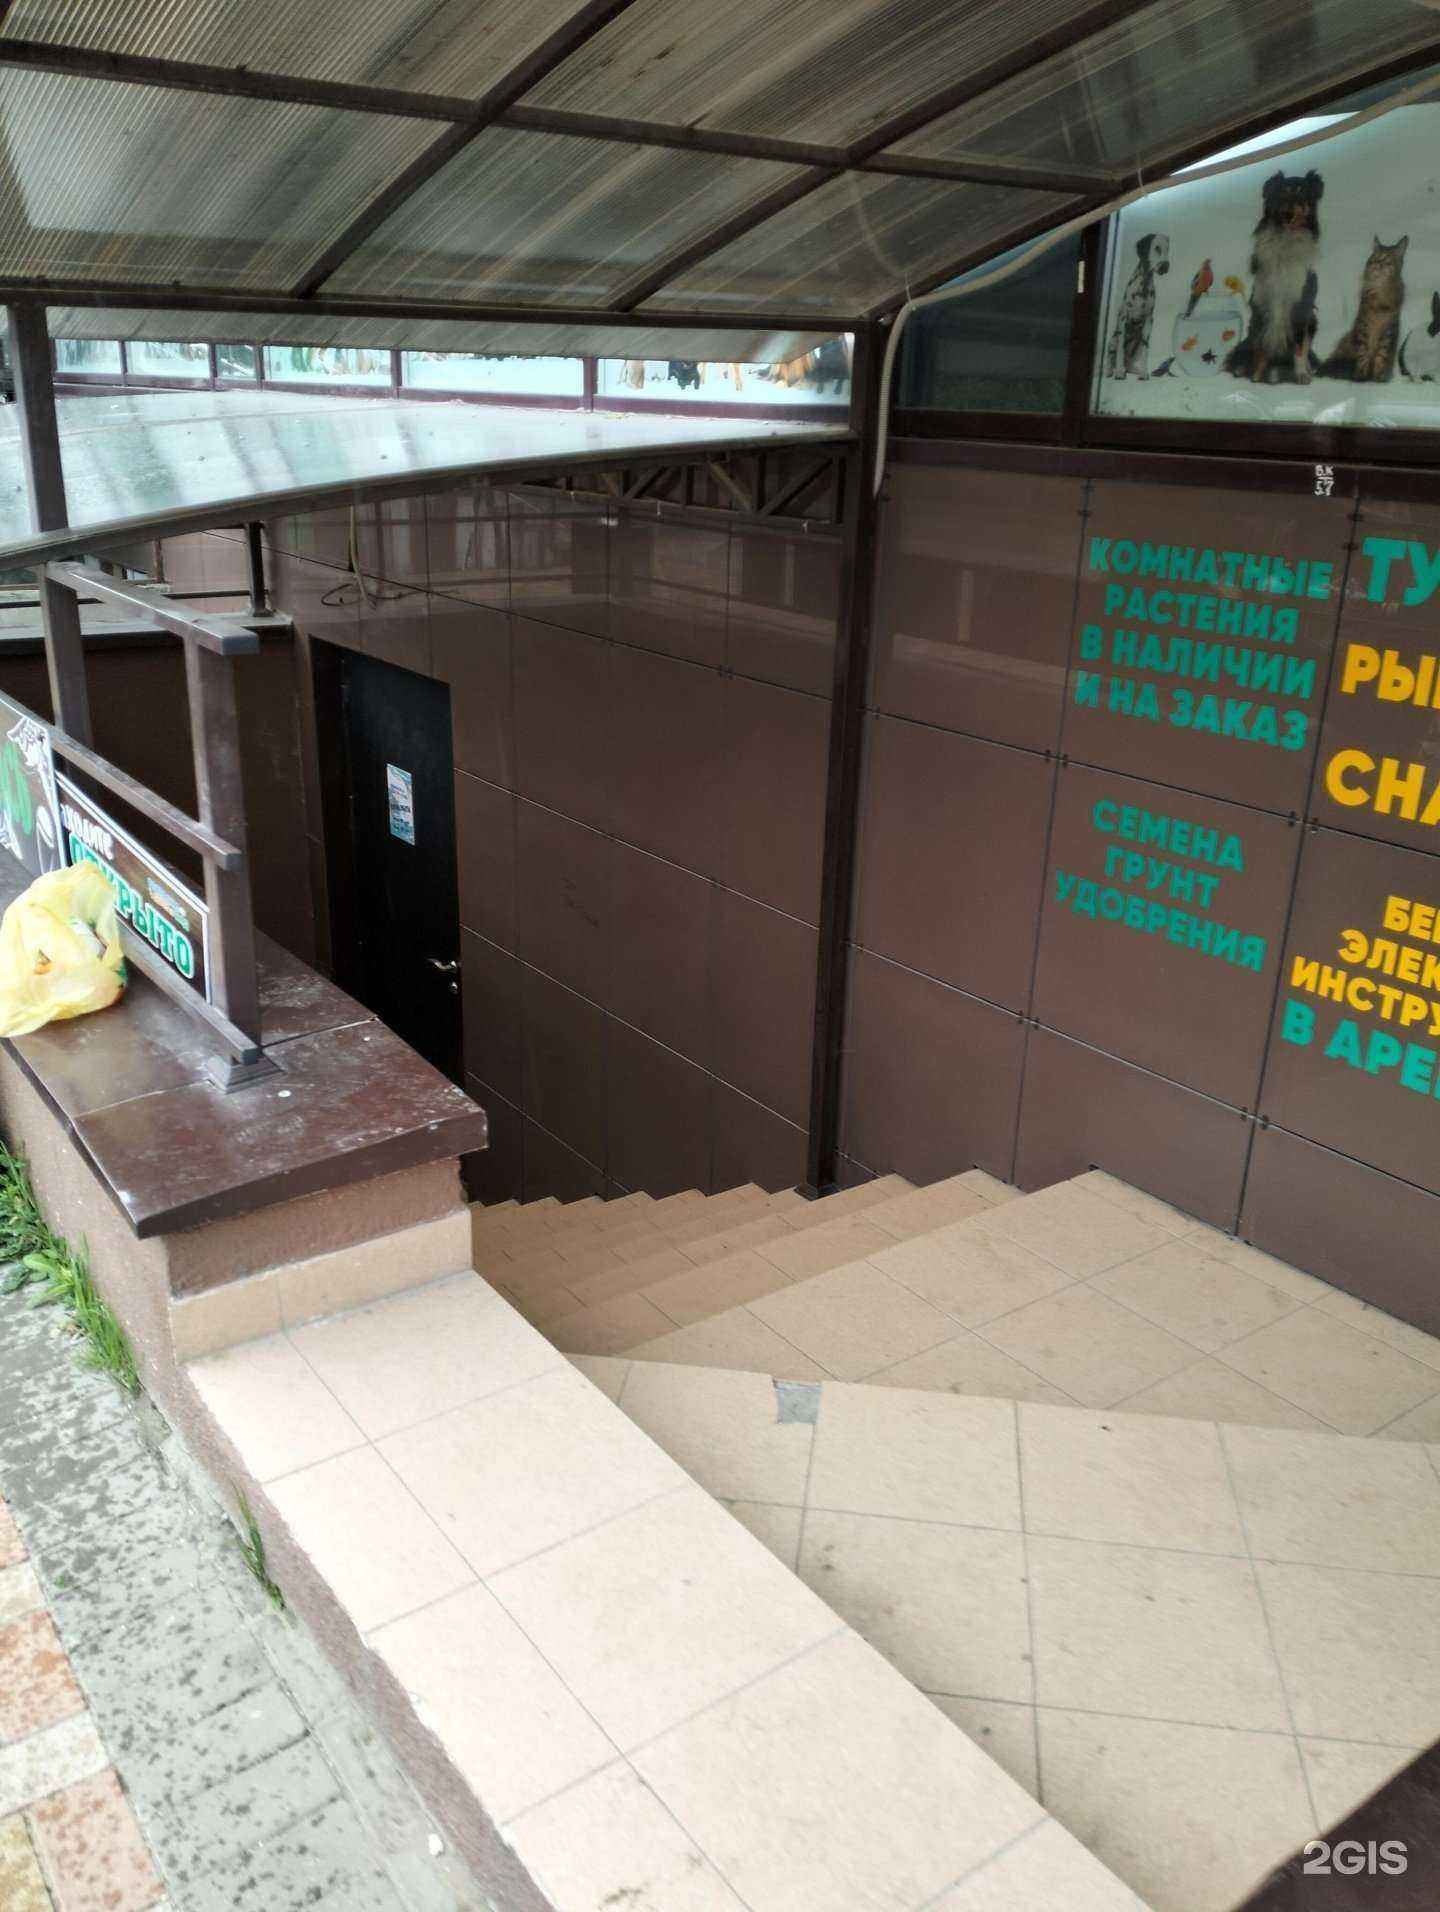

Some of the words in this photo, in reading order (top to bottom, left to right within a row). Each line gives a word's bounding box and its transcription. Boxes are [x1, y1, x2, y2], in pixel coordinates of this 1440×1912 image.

[1089, 537, 1334, 600] КОМНАТНЫЕ
[1104, 584, 1300, 645] РАСТЕНИЯ
[1079, 624, 1103, 660] В
[1111, 629, 1317, 700] НАЛИЧИИ
[1340, 643, 1440, 710] РЫ
[1074, 670, 1102, 708] И
[1108, 674, 1161, 721] НА
[1169, 687, 1309, 752] ЗАКАЗ
[1092, 798, 1245, 873] СЕМЕНА
[70, 831, 195, 979] ОРЫТО
[1105, 844, 1221, 910] ГРУНТ
[1056, 870, 1268, 972] УДОБРЕНИЯ
[1383, 896, 1440, 944] БЕ
[1280, 998, 1317, 1047] В
[1323, 1017, 1440, 1101] АРЕ
